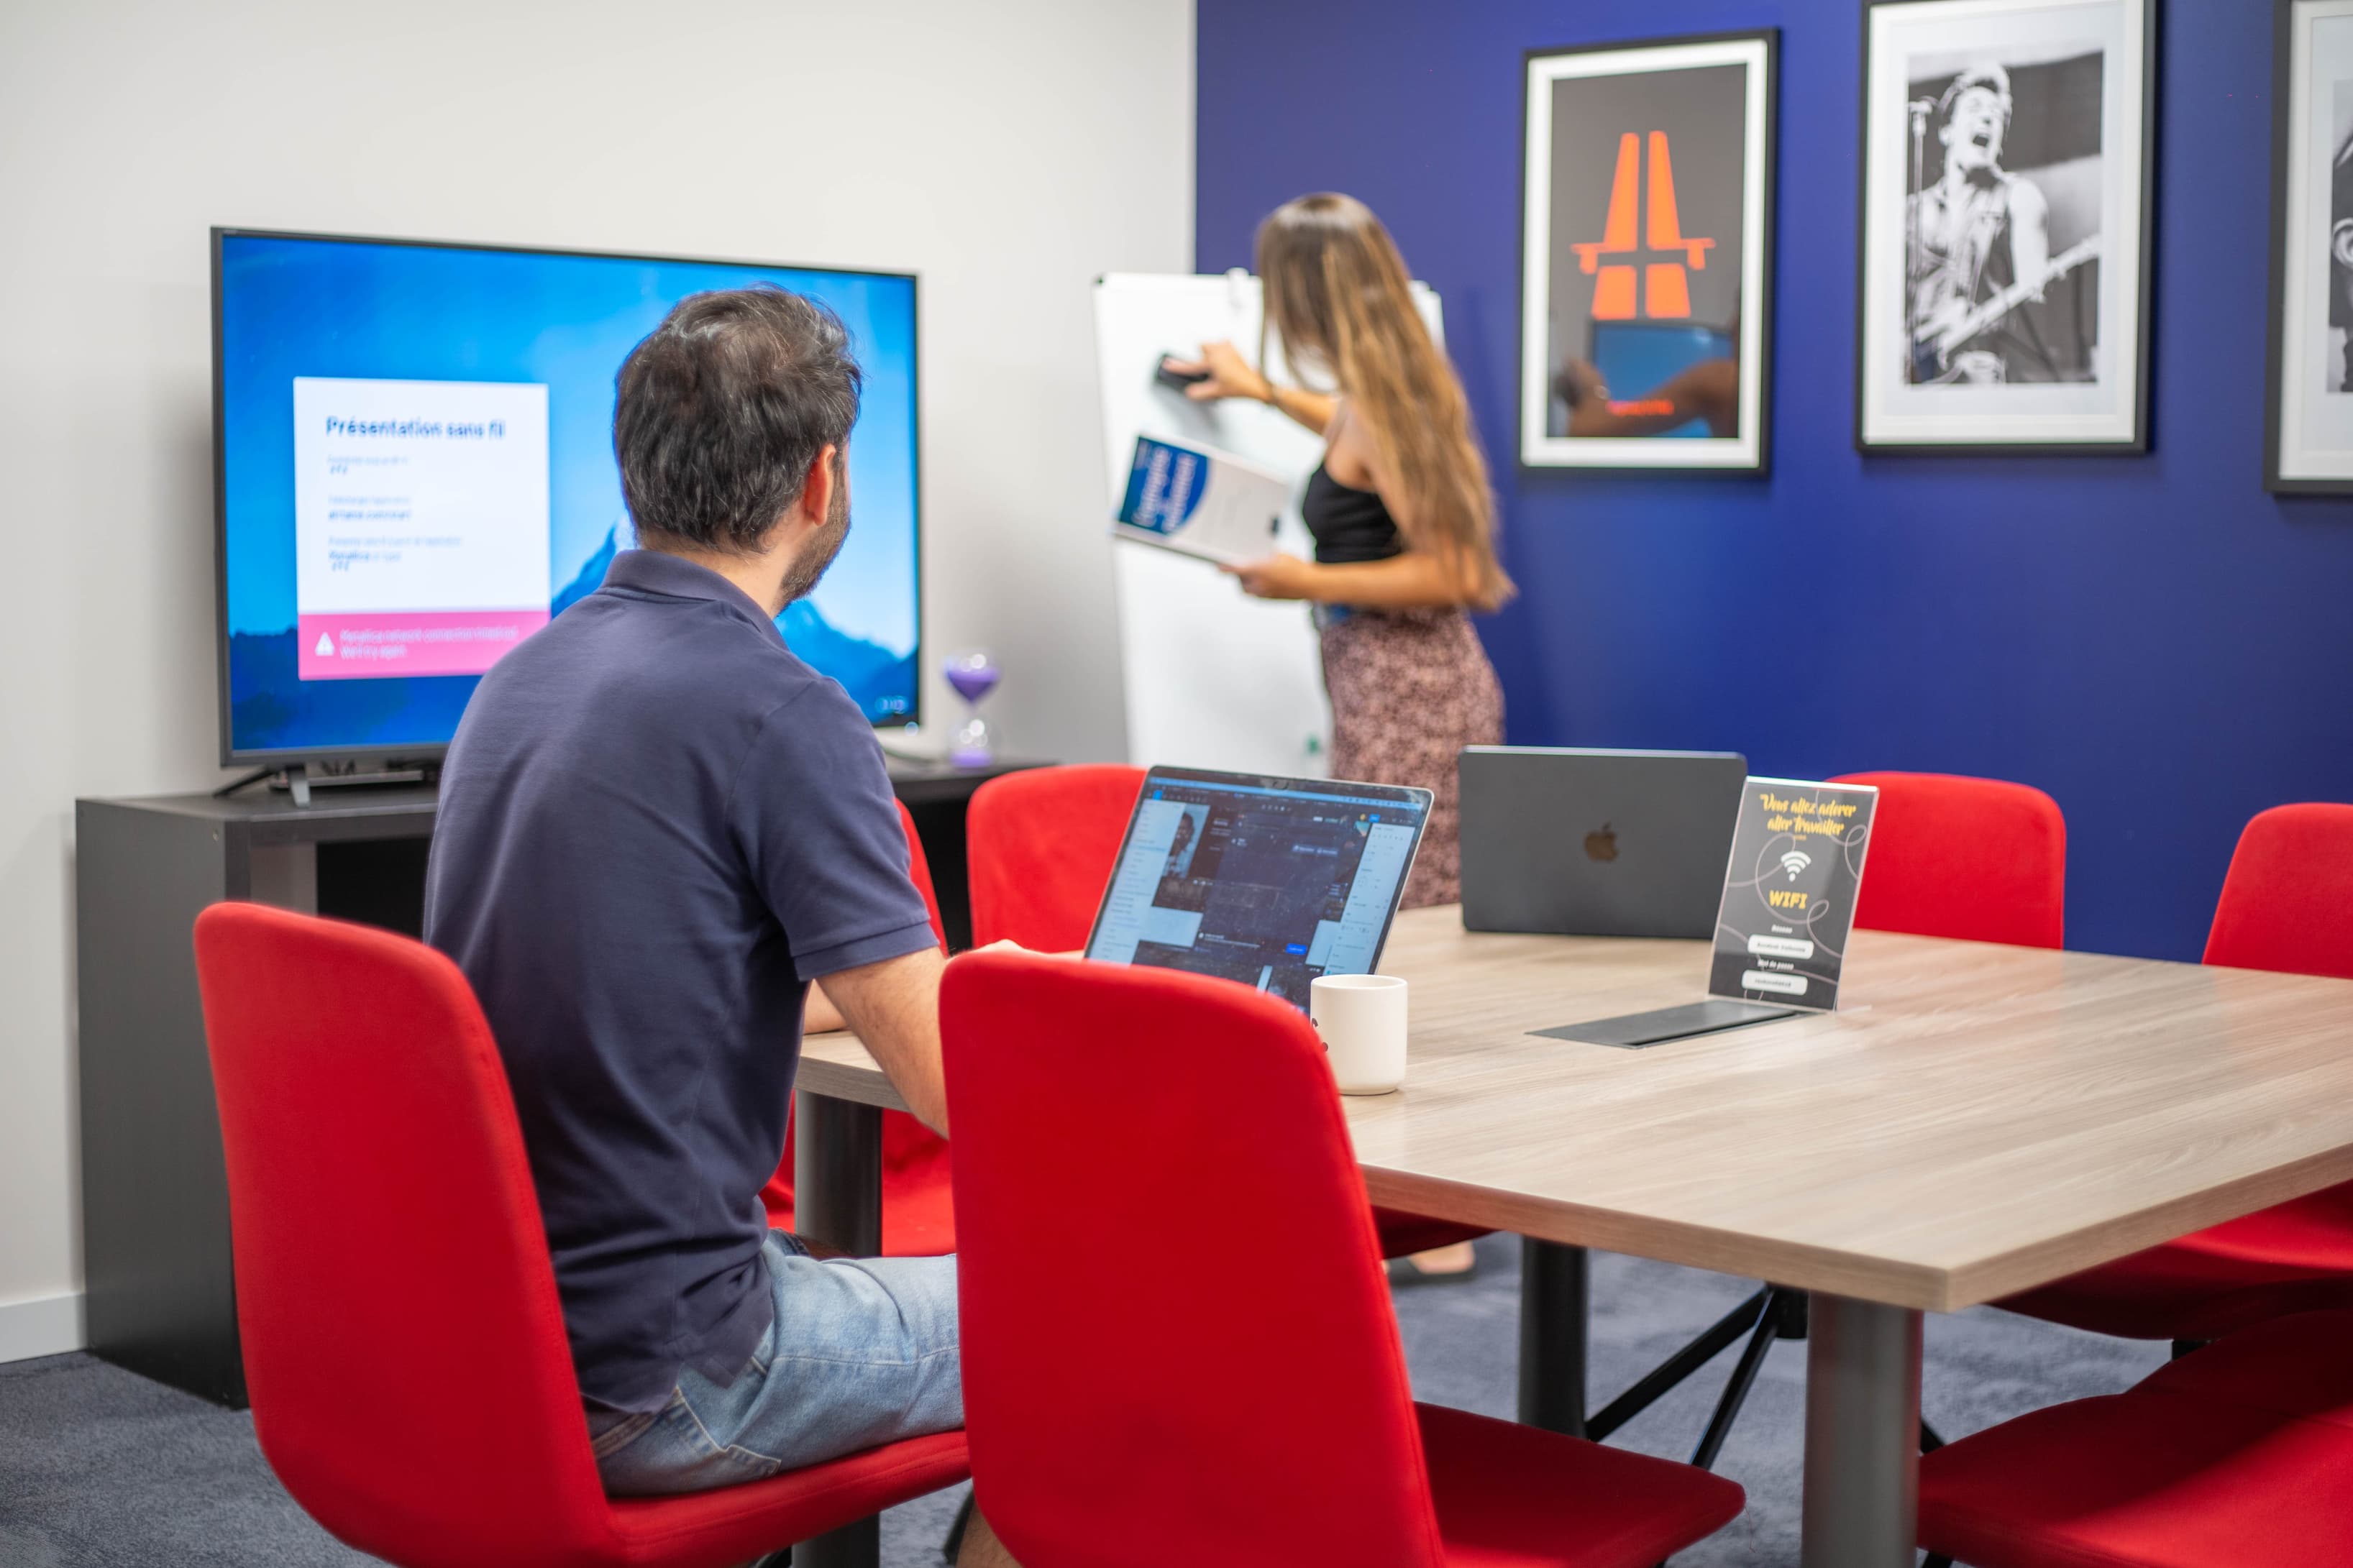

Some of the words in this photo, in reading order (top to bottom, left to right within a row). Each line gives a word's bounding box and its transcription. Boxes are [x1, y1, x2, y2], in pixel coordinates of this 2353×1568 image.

[326, 415, 442, 438] Présentation
[446, 421, 484, 439] sans
[488, 419, 506, 439] fil
[1760, 792, 1789, 812] Vous
[1790, 796, 1816, 815] allez
[1818, 799, 1856, 817] adorer
[1767, 813, 1793, 832] aller
[1769, 889, 1808, 909] WIFI
